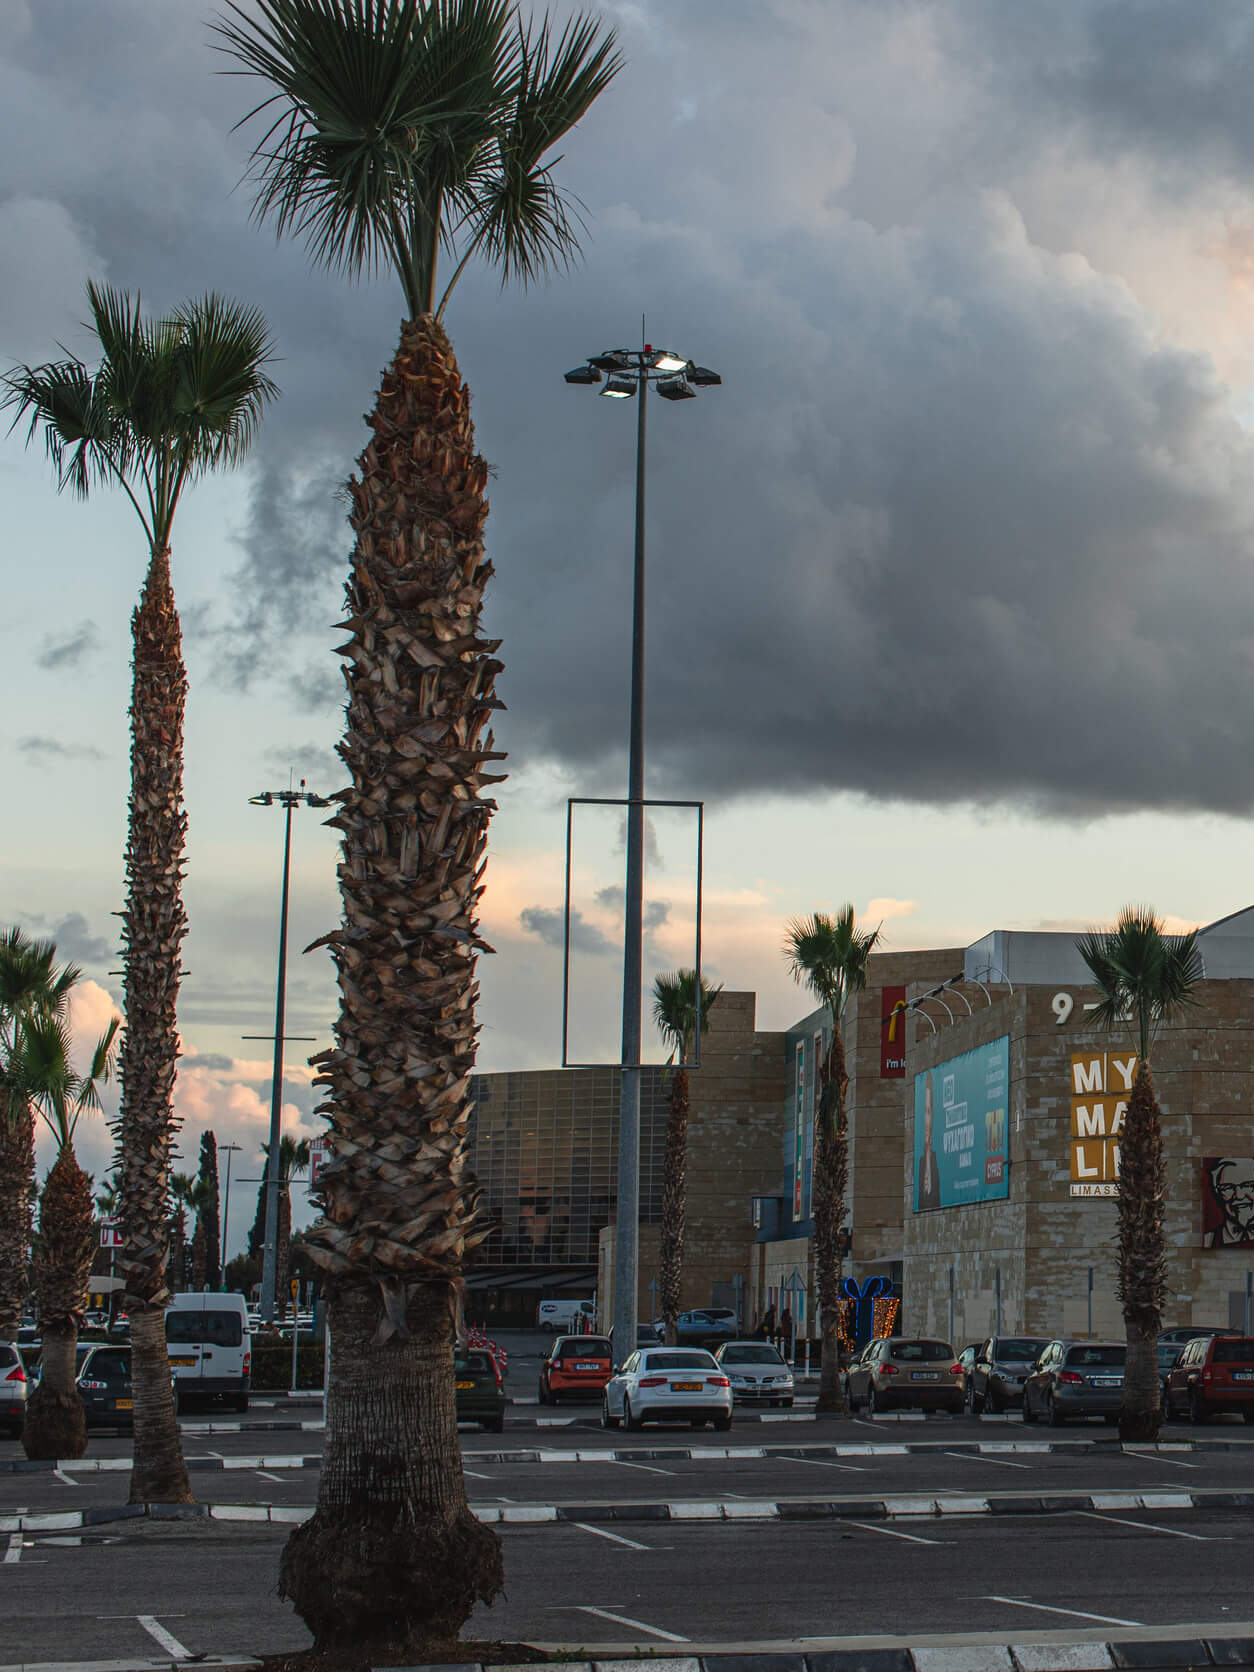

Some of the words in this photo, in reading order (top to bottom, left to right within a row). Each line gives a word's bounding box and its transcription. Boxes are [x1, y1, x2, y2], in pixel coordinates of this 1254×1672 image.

[1052, 992, 1074, 1025] 9
[1073, 1056, 1137, 1094] MY
[1071, 1185, 1121, 1196] LIMASS
